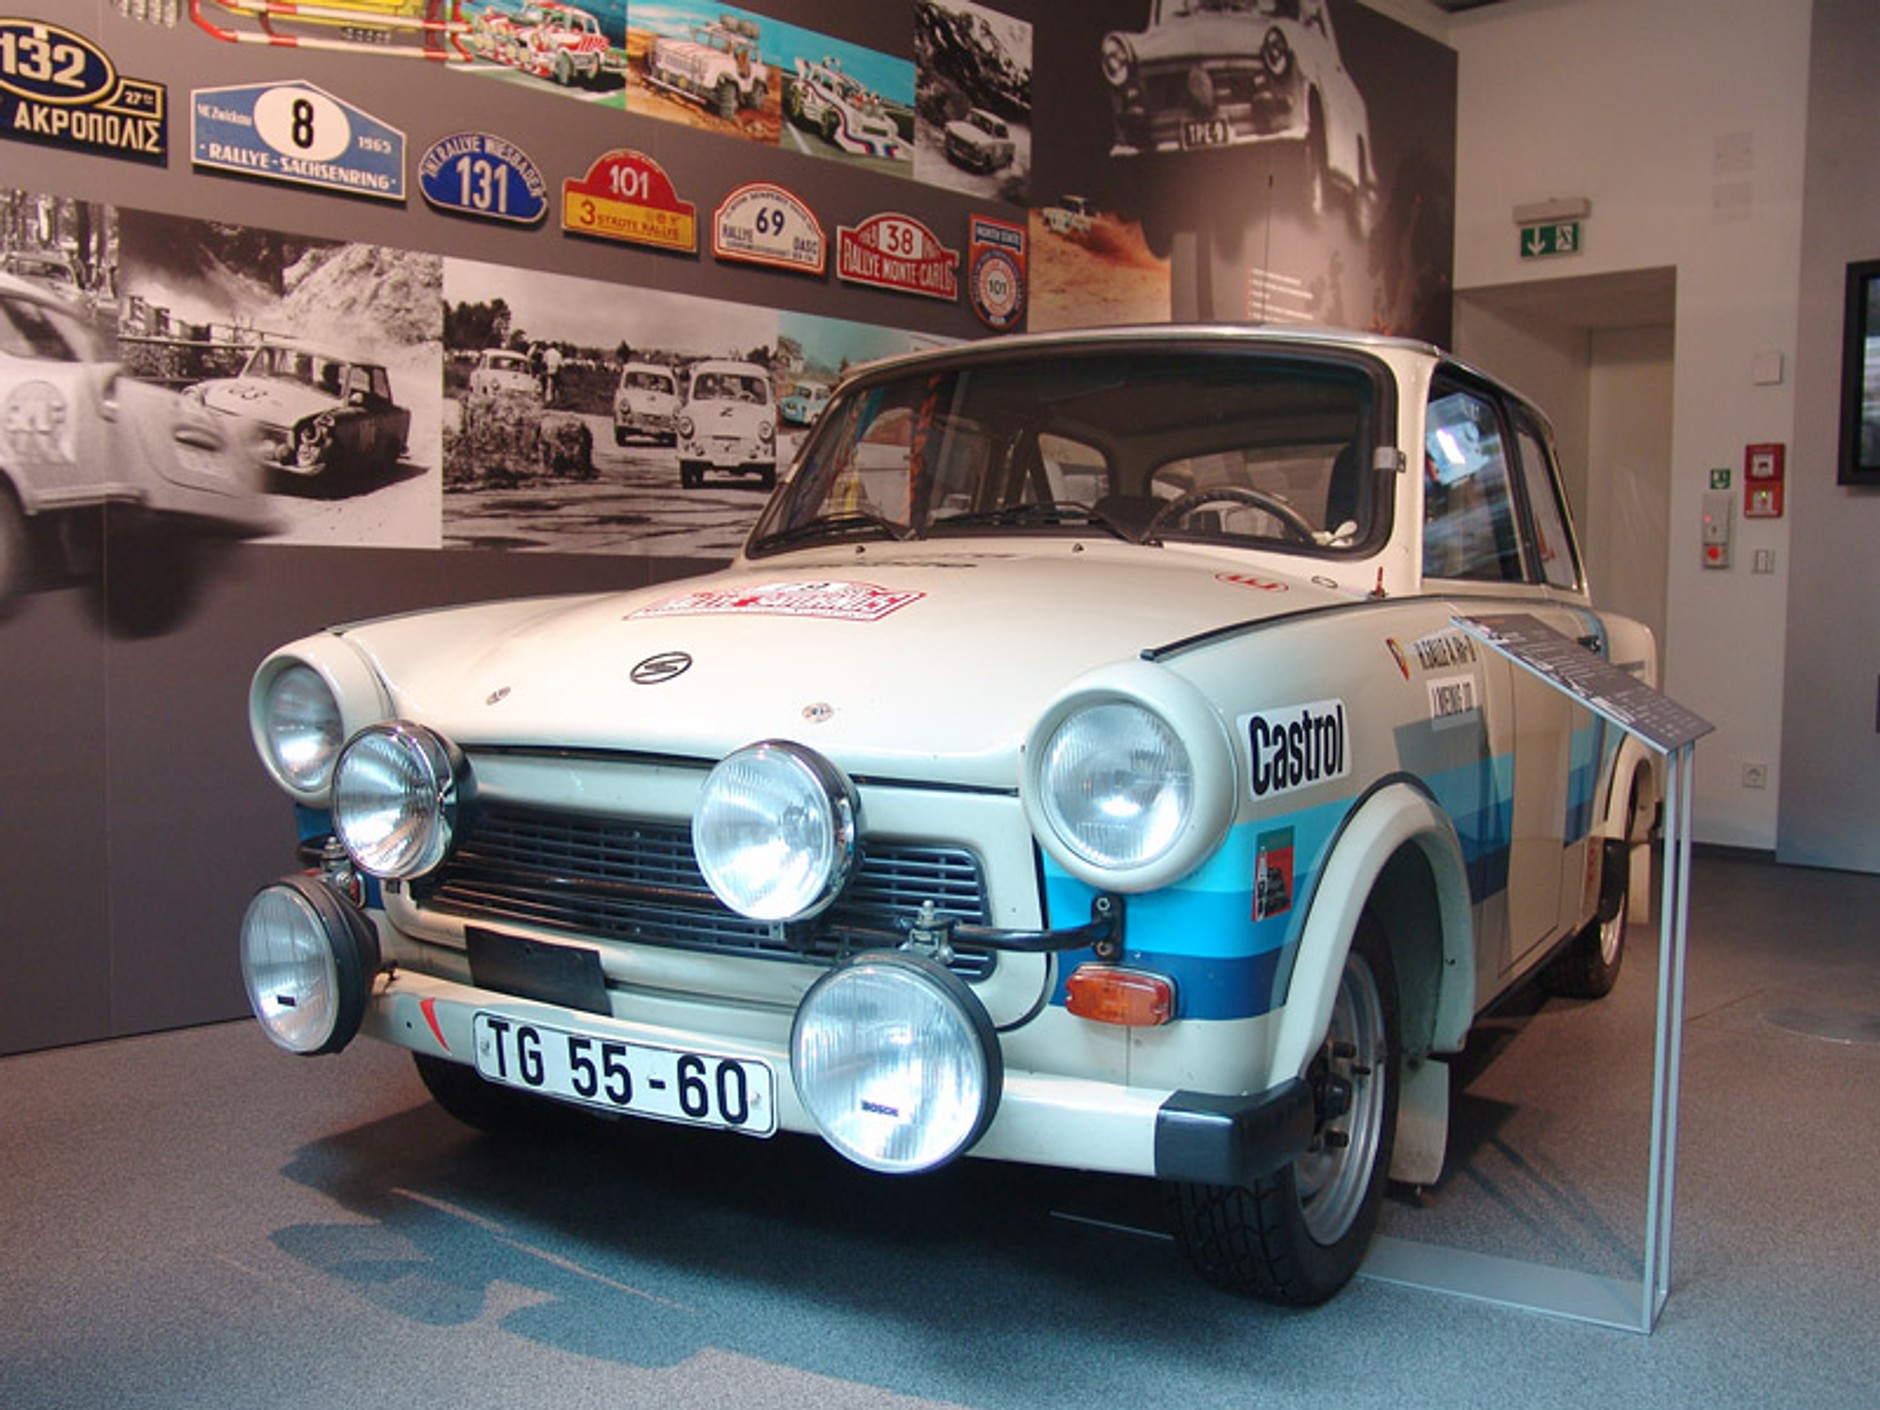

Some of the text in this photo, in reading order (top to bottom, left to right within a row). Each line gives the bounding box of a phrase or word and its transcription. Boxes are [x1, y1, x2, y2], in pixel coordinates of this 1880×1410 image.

[0, 32, 86, 89] 132
[292, 98, 314, 149] 8
[456, 156, 508, 214] 131
[610, 164, 649, 200] 101
[580, 200, 595, 225] 3
[756, 206, 785, 236] 69
[843, 237, 880, 278] RALLYE
[887, 223, 913, 255] 38
[1248, 705, 1344, 796] Castrol
[487, 1020, 545, 1086] TG
